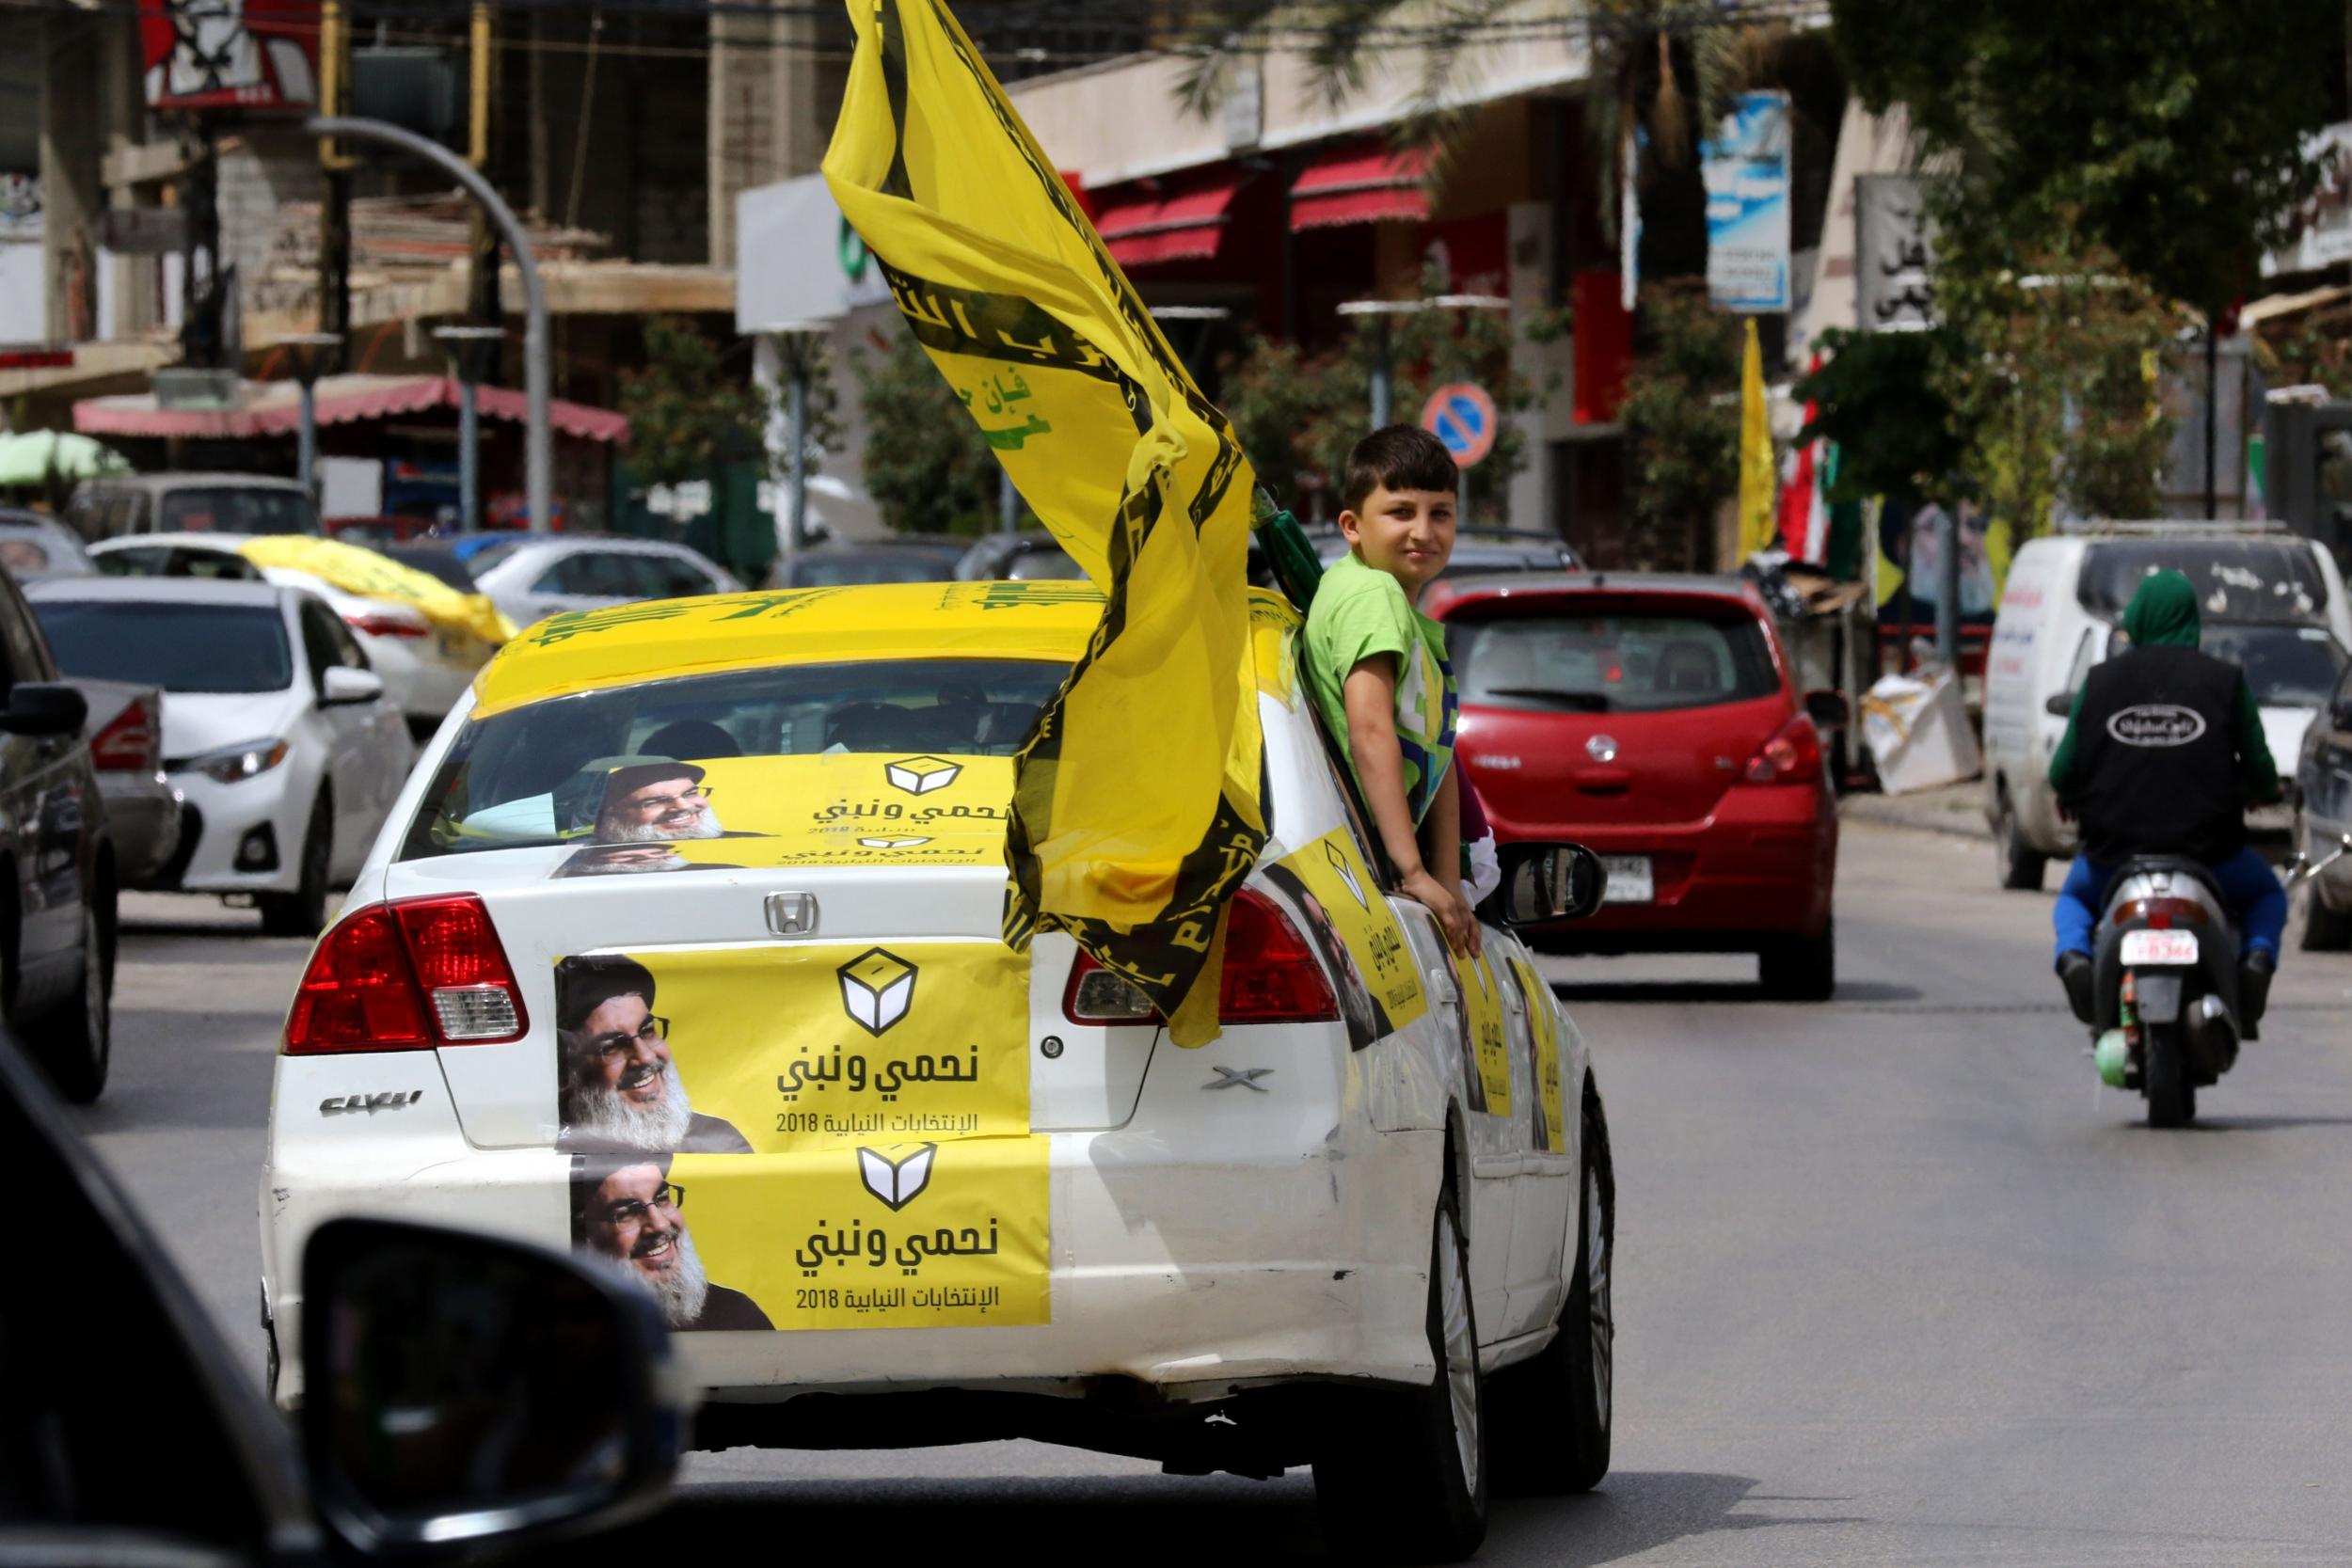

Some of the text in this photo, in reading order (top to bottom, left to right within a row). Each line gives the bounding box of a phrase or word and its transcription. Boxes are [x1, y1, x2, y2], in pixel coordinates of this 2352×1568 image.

[812, 799, 1010, 825] نحمي ونبني
[776, 1044, 978, 1102] نحمي ونبني
[775, 1113, 978, 1137] الإنتخابات النيابية 2018
[795, 1217, 998, 1277] نحمي ونبني
[796, 1286, 999, 1314] الإنتخابات النيابية 2018
